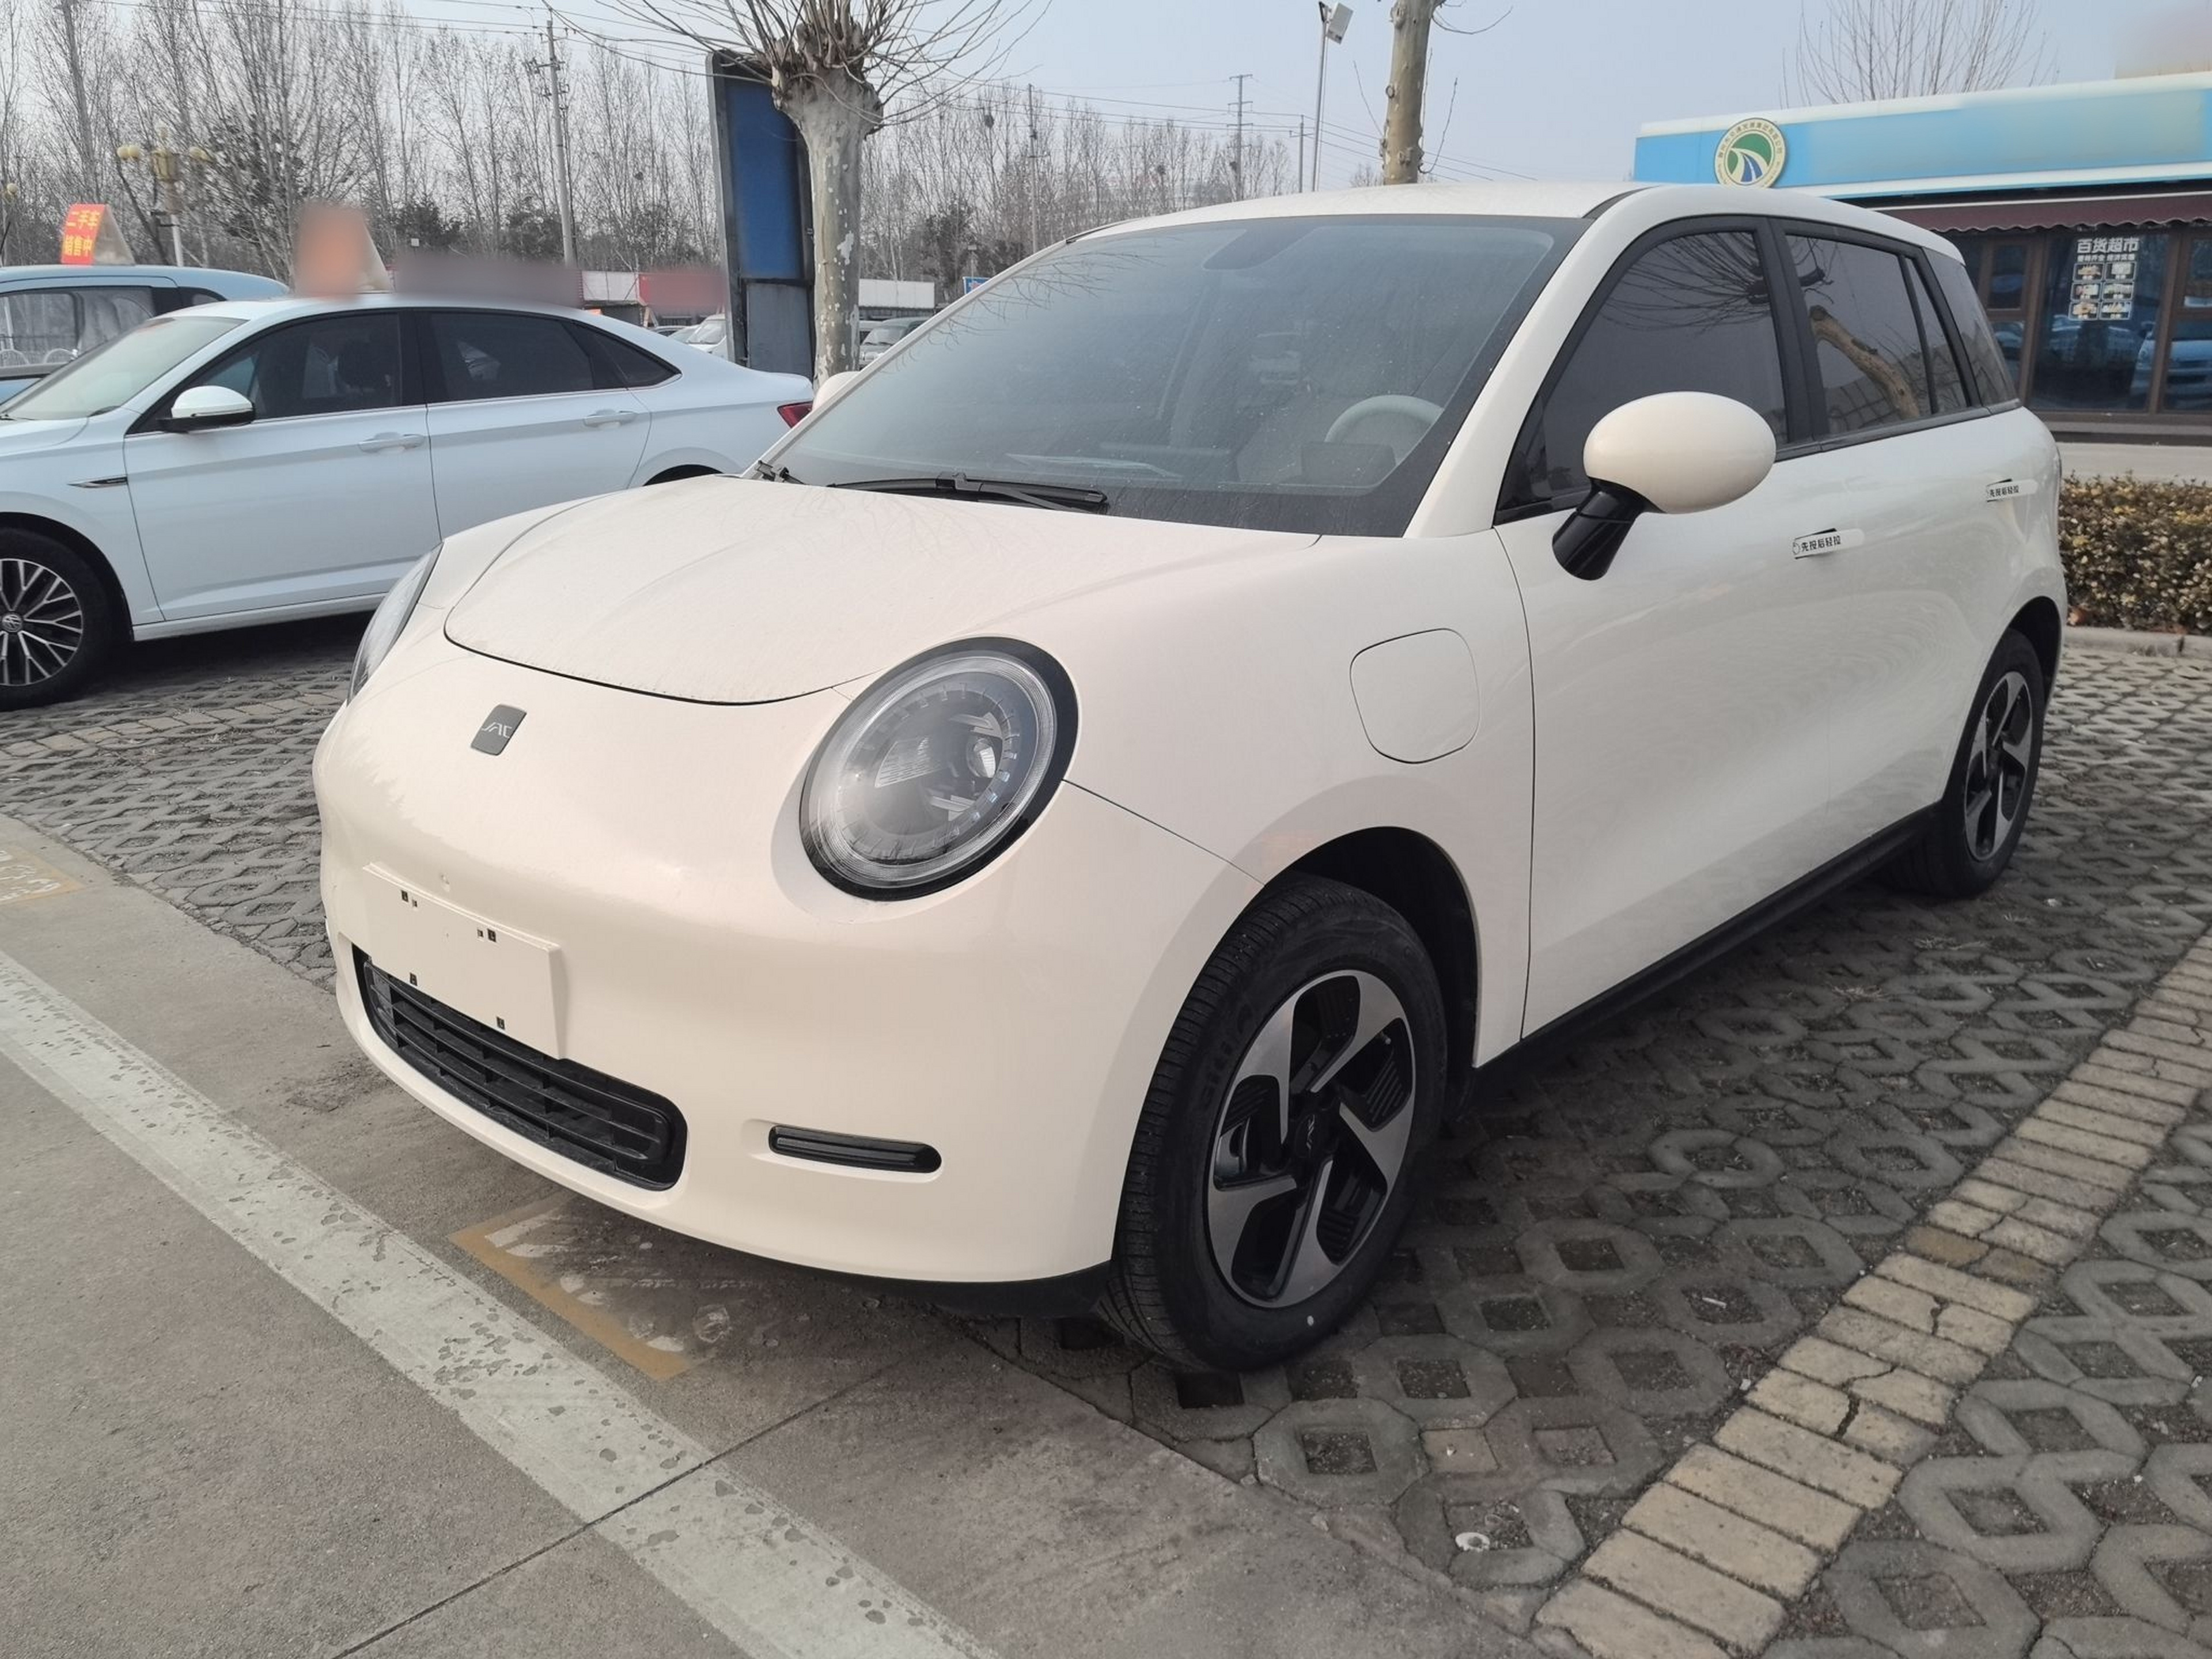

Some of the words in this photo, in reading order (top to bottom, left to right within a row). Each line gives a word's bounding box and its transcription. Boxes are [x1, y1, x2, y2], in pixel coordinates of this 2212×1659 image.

[66, 210, 101, 230] 二手车
[63, 235, 94, 257] 销售中
[2077, 237, 2139, 253] 百货超市
